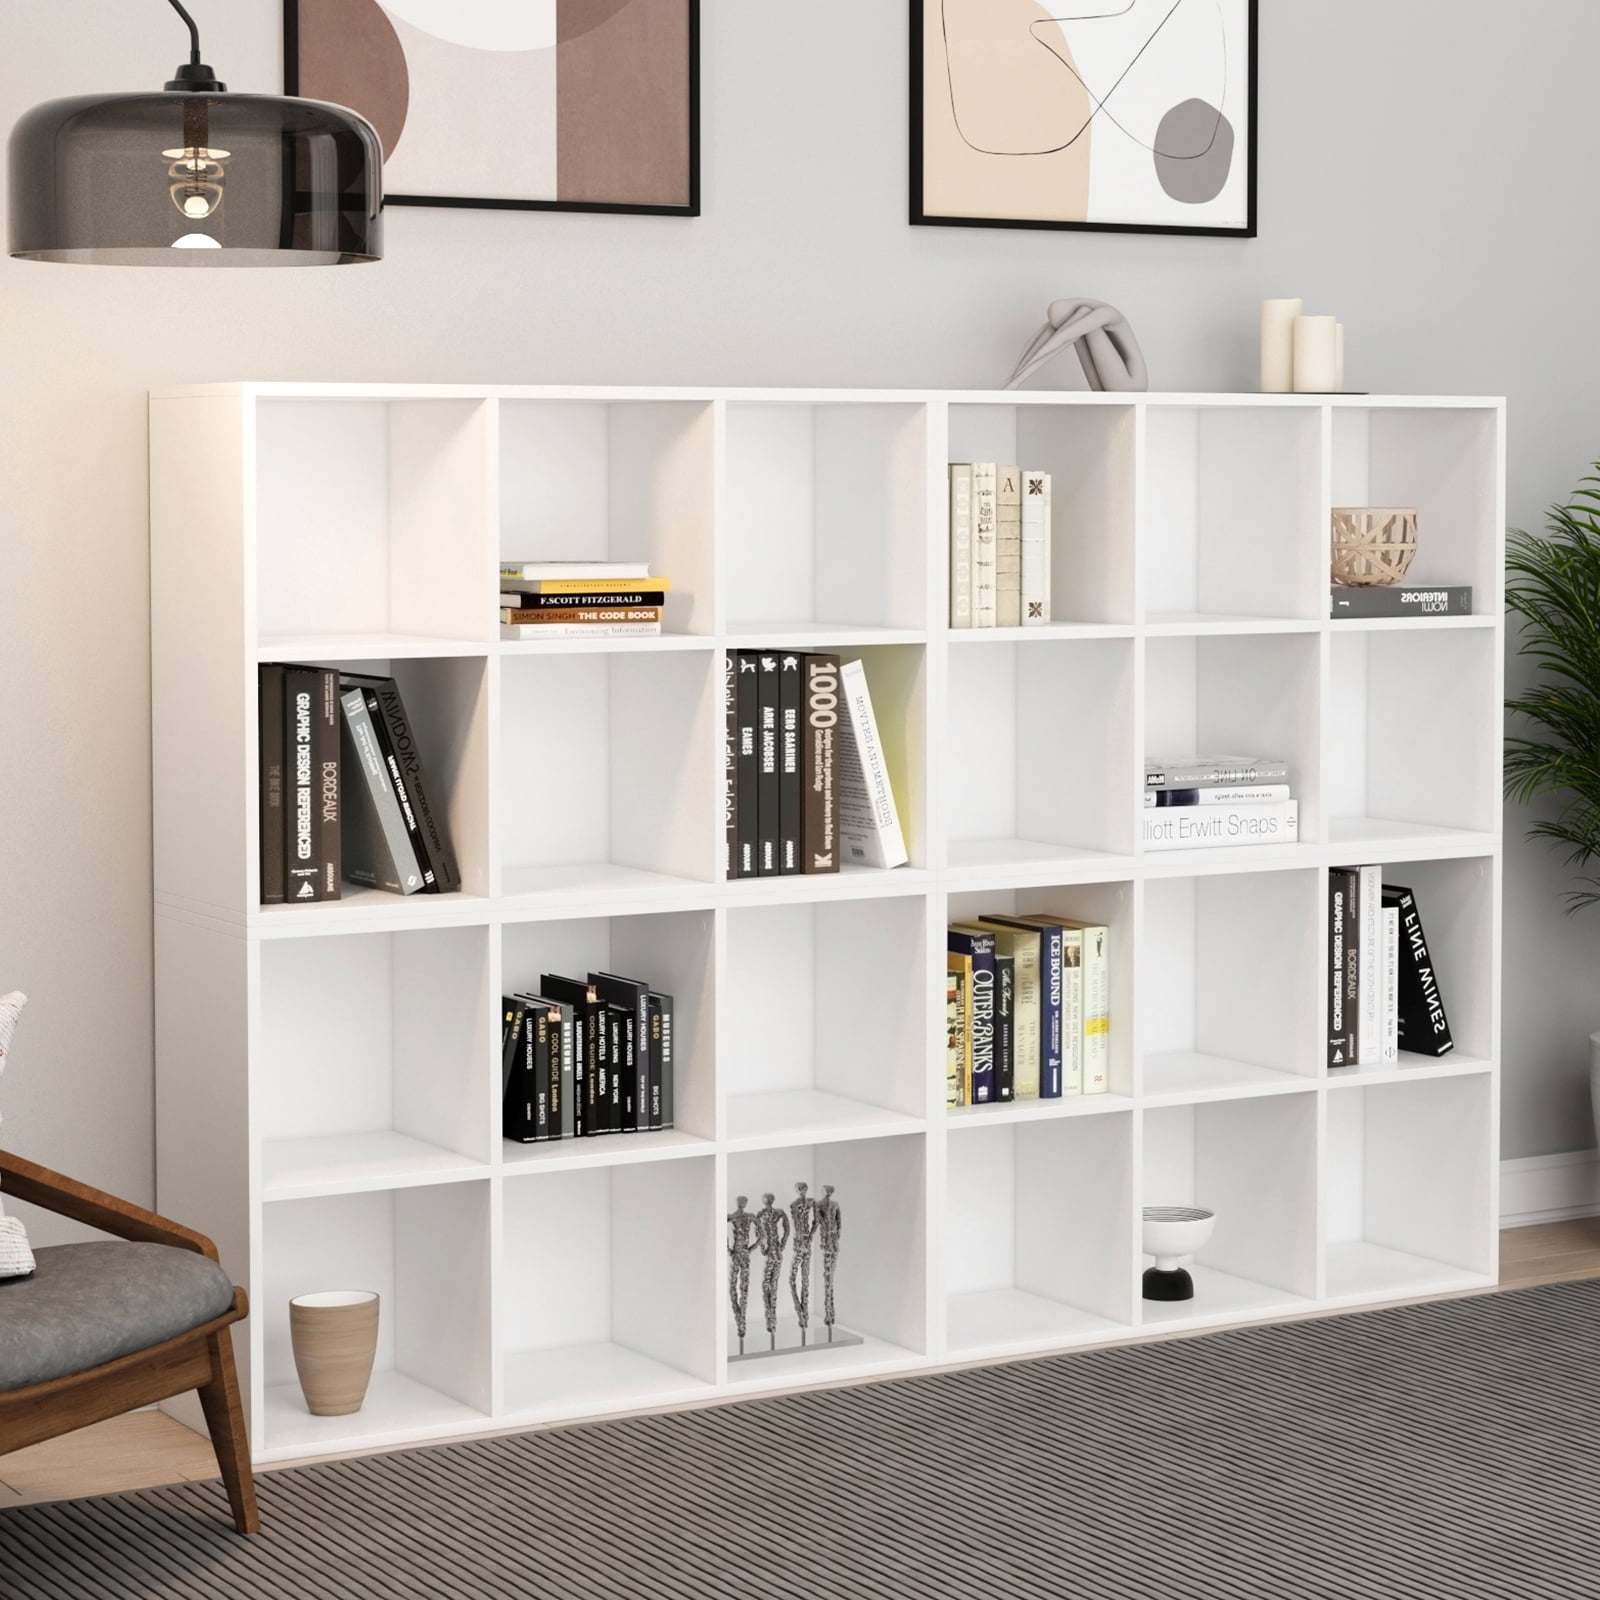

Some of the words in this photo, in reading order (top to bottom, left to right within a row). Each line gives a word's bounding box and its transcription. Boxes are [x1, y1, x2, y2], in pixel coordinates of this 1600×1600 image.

[1003, 478, 1014, 492] A
[540, 596, 581, 605] F.SCOTT
[582, 595, 643, 605] FITZGERALD
[513, 612, 545, 621] SIMON
[547, 612, 576, 621] SINGH
[578, 611, 598, 620] THE
[600, 611, 626, 620] CODE
[628, 610, 656, 619] BOOK
[611, 626, 657, 635] Information
[809, 662, 838, 728] 1000
[296, 692, 310, 742] GRAPHIC
[763, 706, 774, 730] ARNE
[785, 708, 796, 731] EERO
[742, 727, 753, 756] EAMES
[763, 731, 774, 774] JACOBSEN
[785, 731, 796, 774] SAARINEN
[297, 744, 311, 785] DESIGN
[855, 695, 874, 744] MOVIES
[867, 745, 881, 771] AND
[874, 770, 893, 827] METHODS
[322, 761, 337, 823] BORDEAUX
[297, 787, 312, 860] REFERENCED
[1179, 817, 1222, 839] Erwitt
[1227, 814, 1278, 838] Snaps
[1366, 871, 1376, 901] VISIONARY
[1334, 891, 1343, 934] GRAPHIC
[1366, 902, 1376, 947] ARCHITECTURE
[1021, 946, 1034, 969] JOHN
[1334, 935, 1343, 970] DESIGN
[1366, 949, 1376, 958] OF
[1366, 959, 1375, 972] THE
[1347, 949, 1356, 1000] BORDEAUX
[972, 969, 994, 1020] OUTER
[1333, 971, 1342, 1031] REFERENCED
[1366, 989, 1375, 1022] CENTURY
[511, 1011, 523, 1040] GABO
[538, 1017, 546, 1043] GABO
[662, 1014, 670, 1062] MUSEUMS
[551, 1032, 559, 1055] COOL
[563, 1022, 571, 1072] MUSEUMS
[971, 1020, 994, 1073] BANKS
[1017, 1024, 1026, 1066] MANAGER
[551, 1057, 559, 1082] GUIDE
[575, 1062, 583, 1081] ANGELS
[598, 1067, 606, 1096] AMERICA
[538, 1092, 546, 1104] BIG
[538, 1104, 546, 1125] SHOTS
